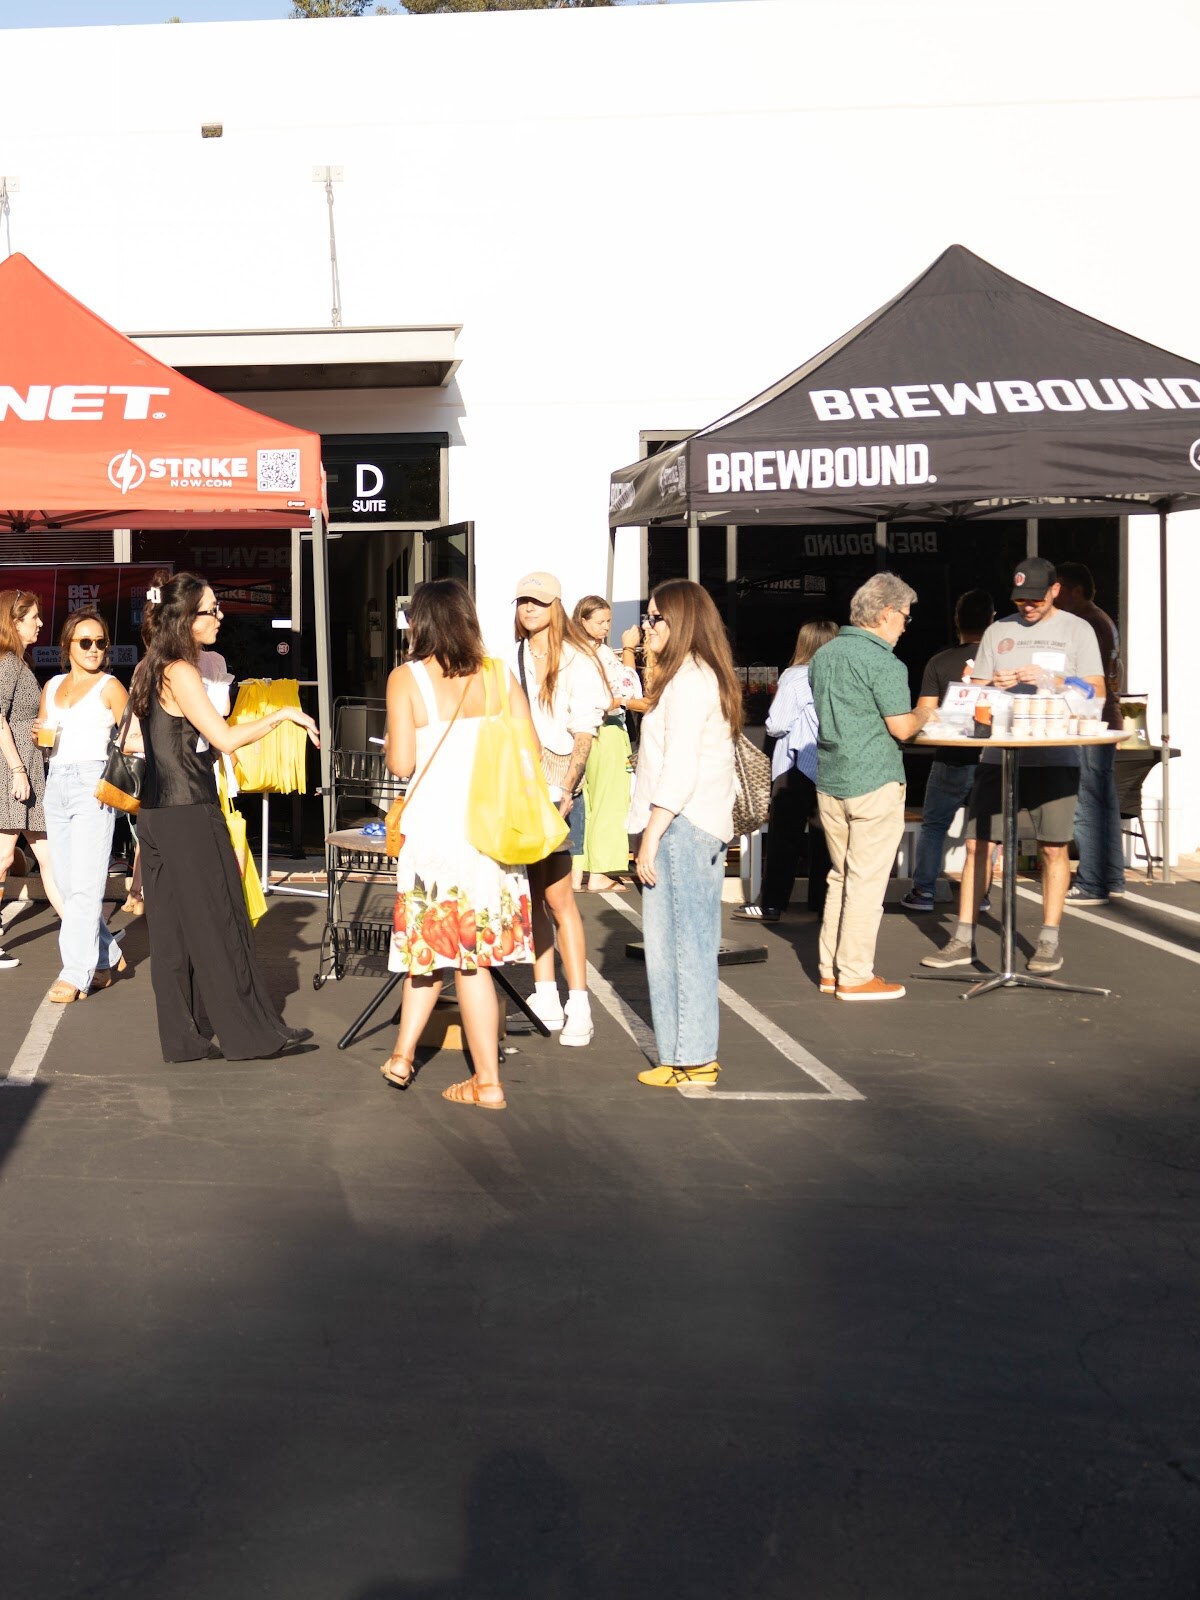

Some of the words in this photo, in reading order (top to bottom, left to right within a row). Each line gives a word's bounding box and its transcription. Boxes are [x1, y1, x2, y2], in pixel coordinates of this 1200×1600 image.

[808, 378, 1200, 421] BREWBOUND
[149, 457, 248, 478] STRIKE
[170, 479, 233, 488] NOW.COM
[356, 463, 384, 498] D
[351, 499, 387, 513] SUITE
[68, 584, 100, 599] BEV
